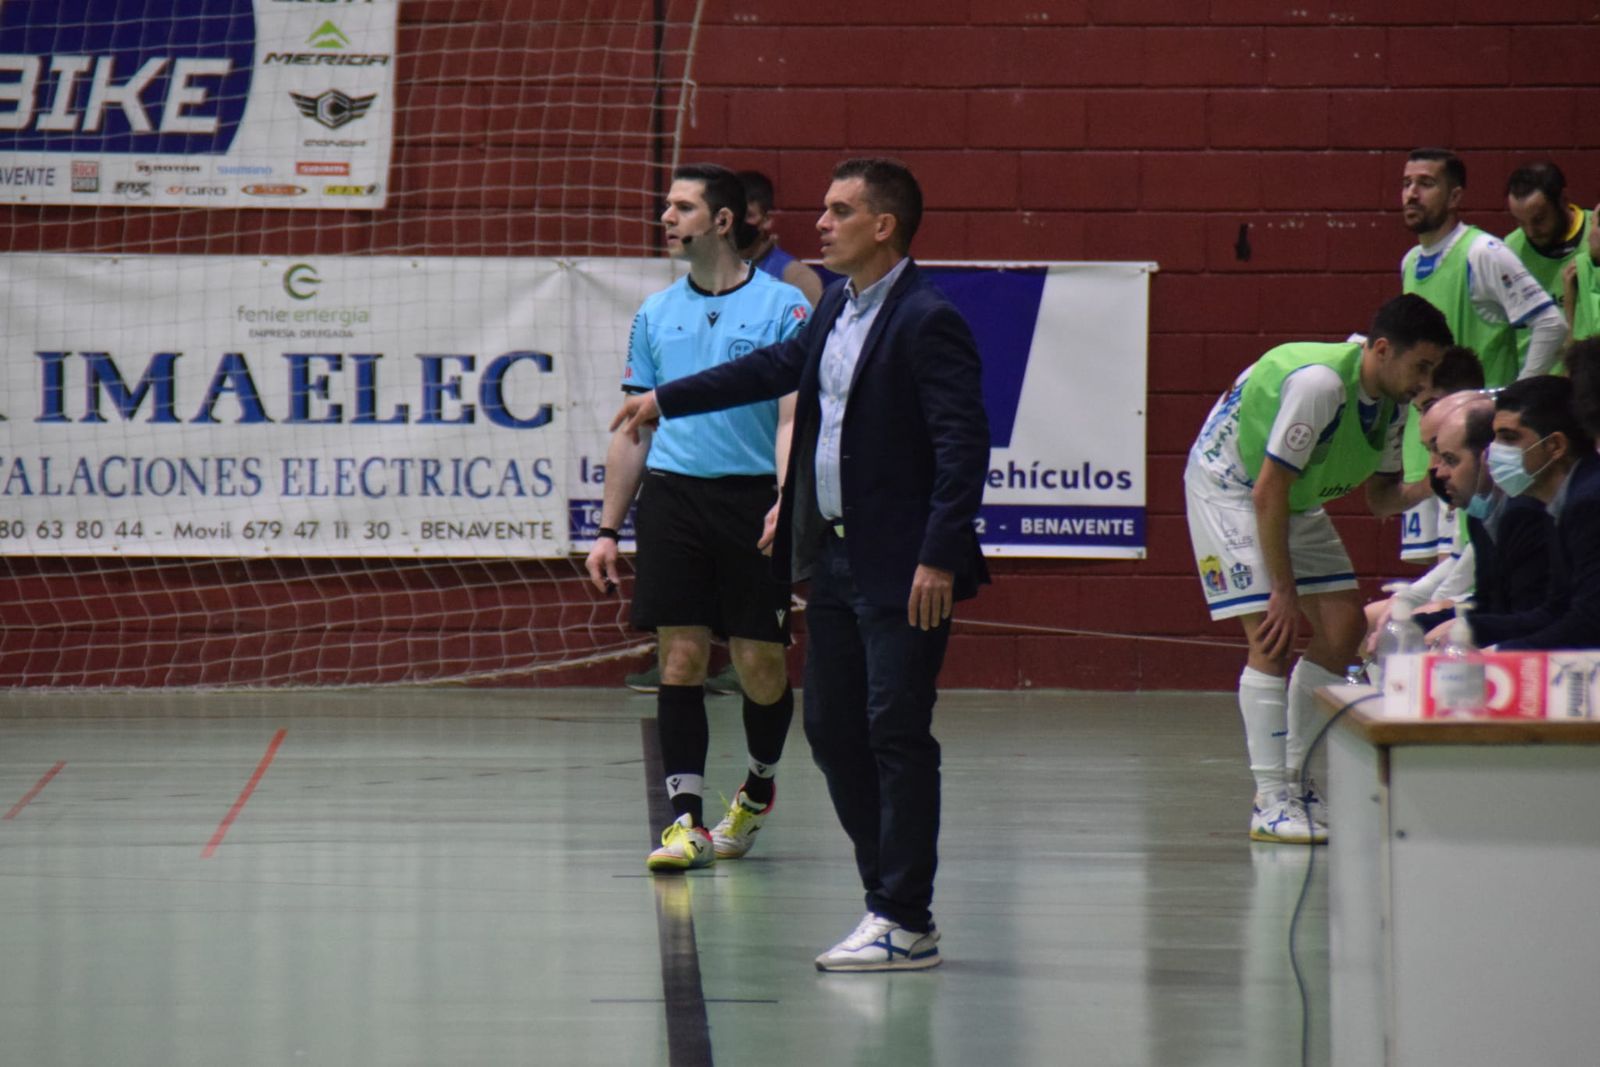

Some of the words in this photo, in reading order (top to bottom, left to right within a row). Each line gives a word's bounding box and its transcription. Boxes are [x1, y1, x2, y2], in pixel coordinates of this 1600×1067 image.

[263, 53, 390, 66] MERIDA
[0, 53, 233, 134] BIKE
[184, 186, 227, 196] GIRO
[237, 305, 286, 322] fenie
[248, 329, 295, 338] EMPRESA
[300, 330, 353, 339] DELEGADA
[33, 350, 553, 429] IMAELEC
[0, 454, 262, 498] ALACIONES
[279, 456, 553, 499] ELECTRICAS
[36, 520, 63, 539] 63
[75, 520, 103, 539] 80
[114, 521, 143, 539] 44
[173, 520, 231, 539] Movil
[242, 521, 283, 540] 679
[294, 521, 319, 539] 47
[363, 521, 390, 539] 30
[420, 521, 552, 540] BENAVENTE
[1020, 518, 1135, 535] BENAVENTE
